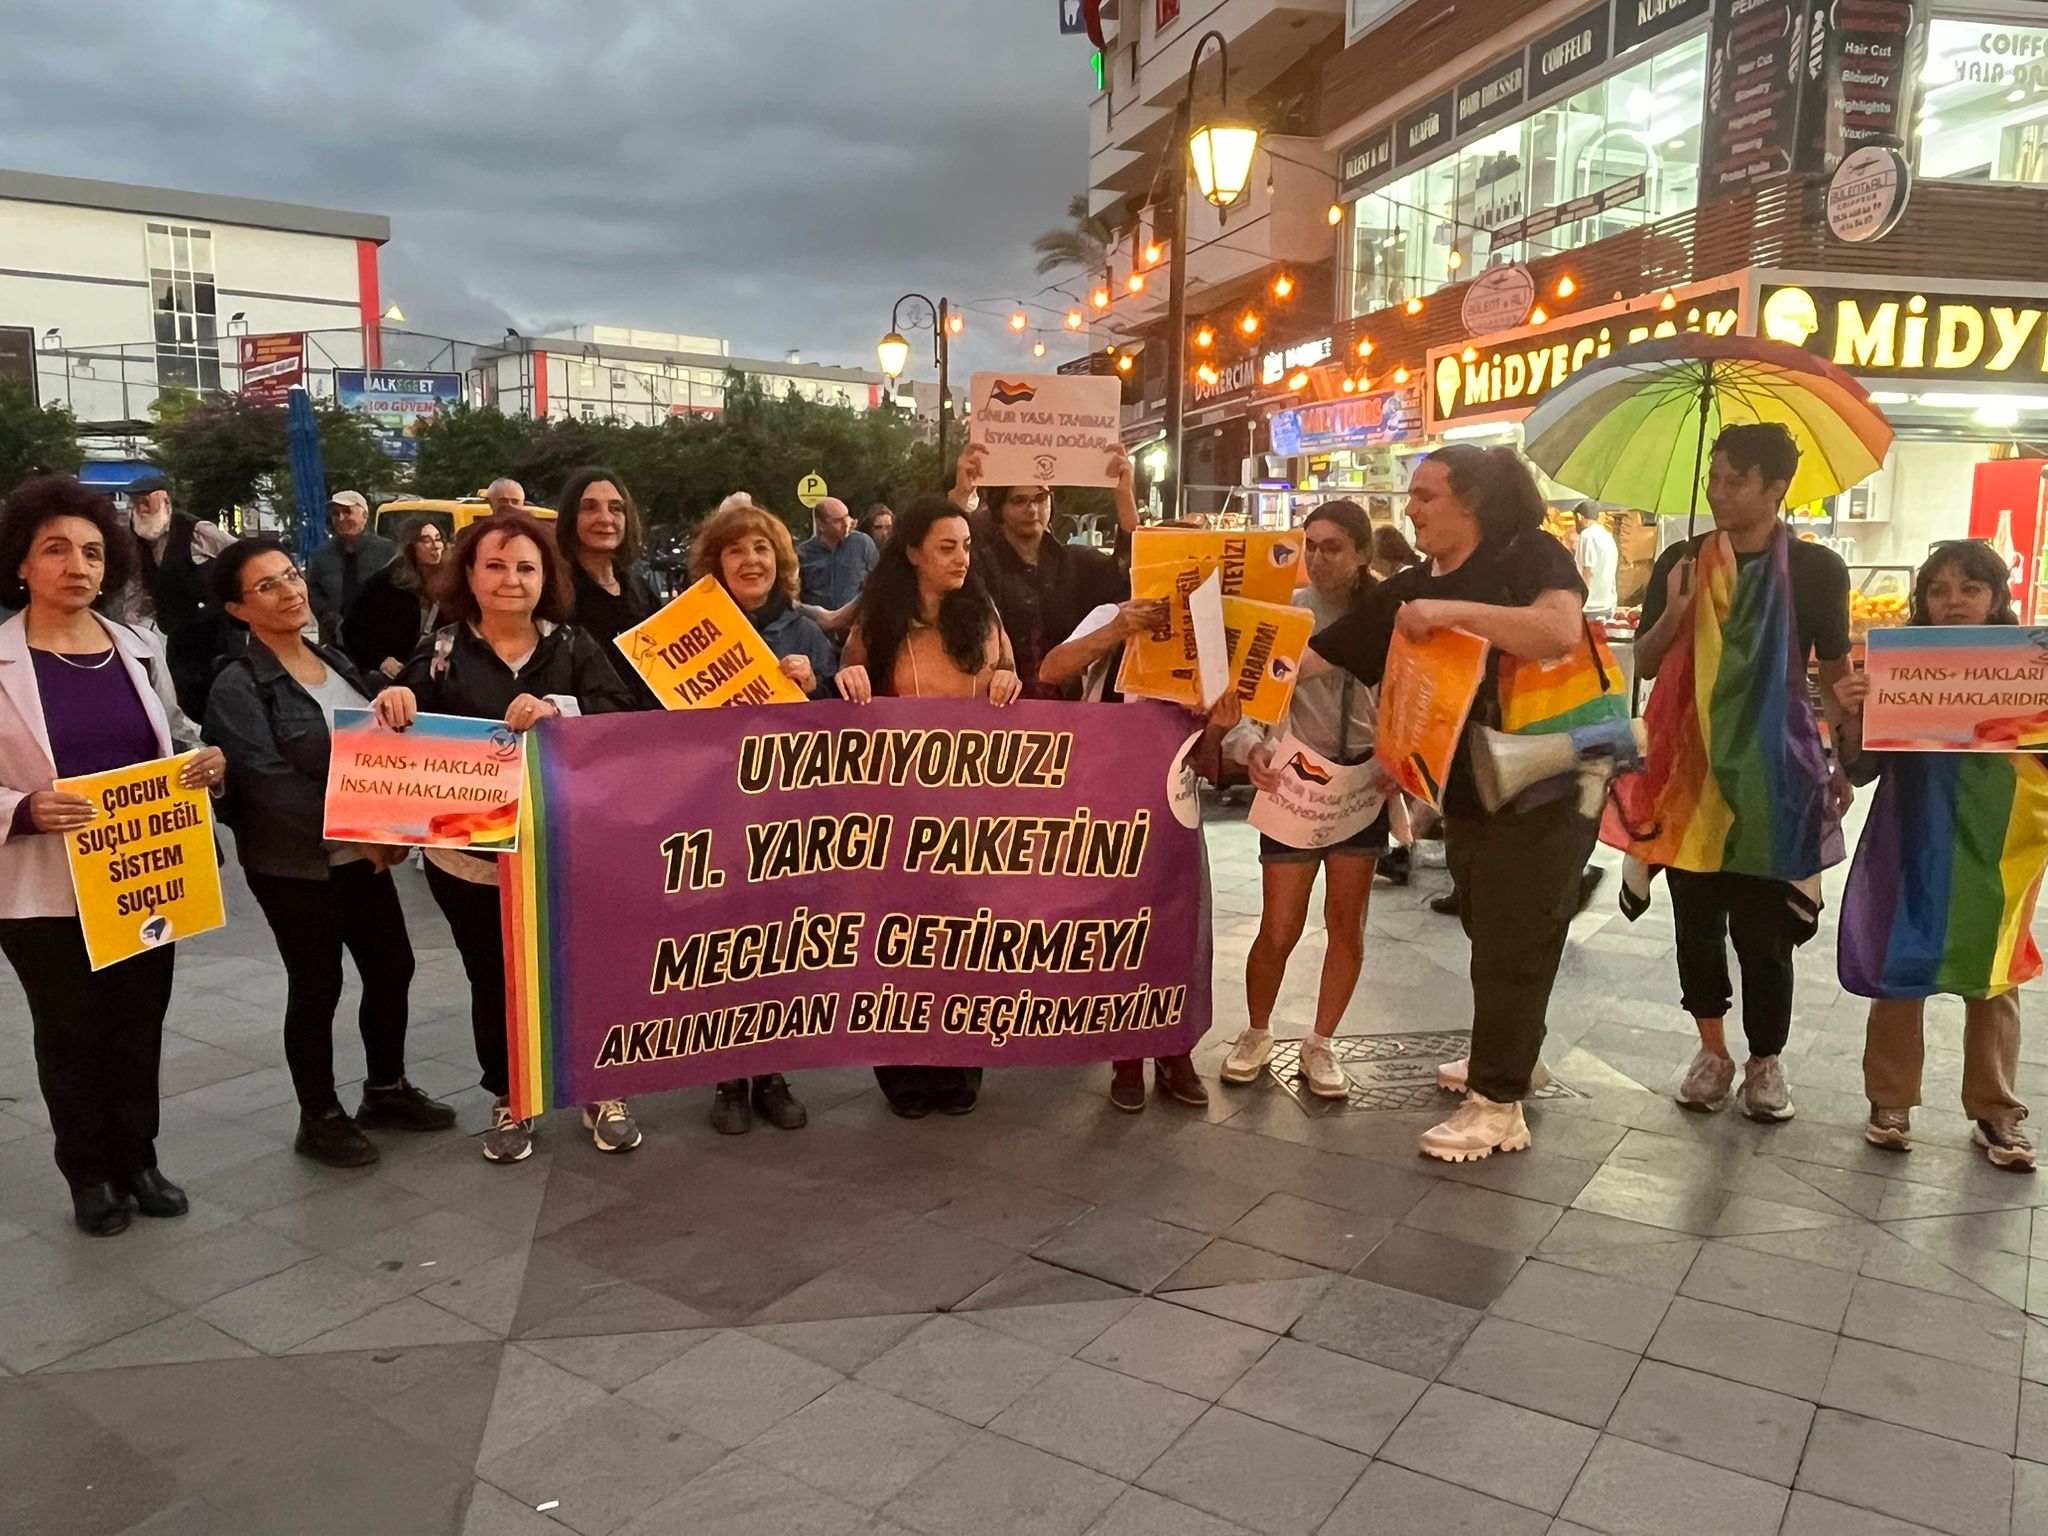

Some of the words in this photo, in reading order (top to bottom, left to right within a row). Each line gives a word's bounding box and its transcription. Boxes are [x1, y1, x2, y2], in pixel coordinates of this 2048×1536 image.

[807, 478, 818, 493] P
[657, 617, 723, 670] TORBA
[673, 640, 754, 706] YASANIZ
[721, 674, 775, 707] SIN!
[1889, 667, 1957, 682] TRANS+
[1964, 667, 2045, 682] HAKLARI
[1878, 688, 1934, 706] İNSAN
[354, 752, 418, 771] TRANS+
[423, 757, 500, 777] HAKLARI
[737, 729, 1074, 794] UYARIYORUZ!
[101, 775, 171, 819] ÇOCUK
[339, 774, 393, 796] İNSAN
[396, 781, 510, 804] HAKLARIDIR!
[76, 818, 142, 856] SUÇLU
[148, 800, 204, 838] DEĞİL
[108, 843, 184, 884] SİSTEM
[660, 829, 726, 894] 11.
[746, 812, 893, 883] YARGI
[903, 807, 1151, 878] PAKETİNİ
[116, 876, 185, 916] SUÇLU!
[650, 906, 866, 996] MECLİSE
[874, 906, 1152, 974] GETİRMEYİ
[594, 993, 840, 1070] AKLINIZDAN
[847, 983, 935, 1034] BİLE
[942, 983, 1187, 1048] GEÇİRMEYİN!
